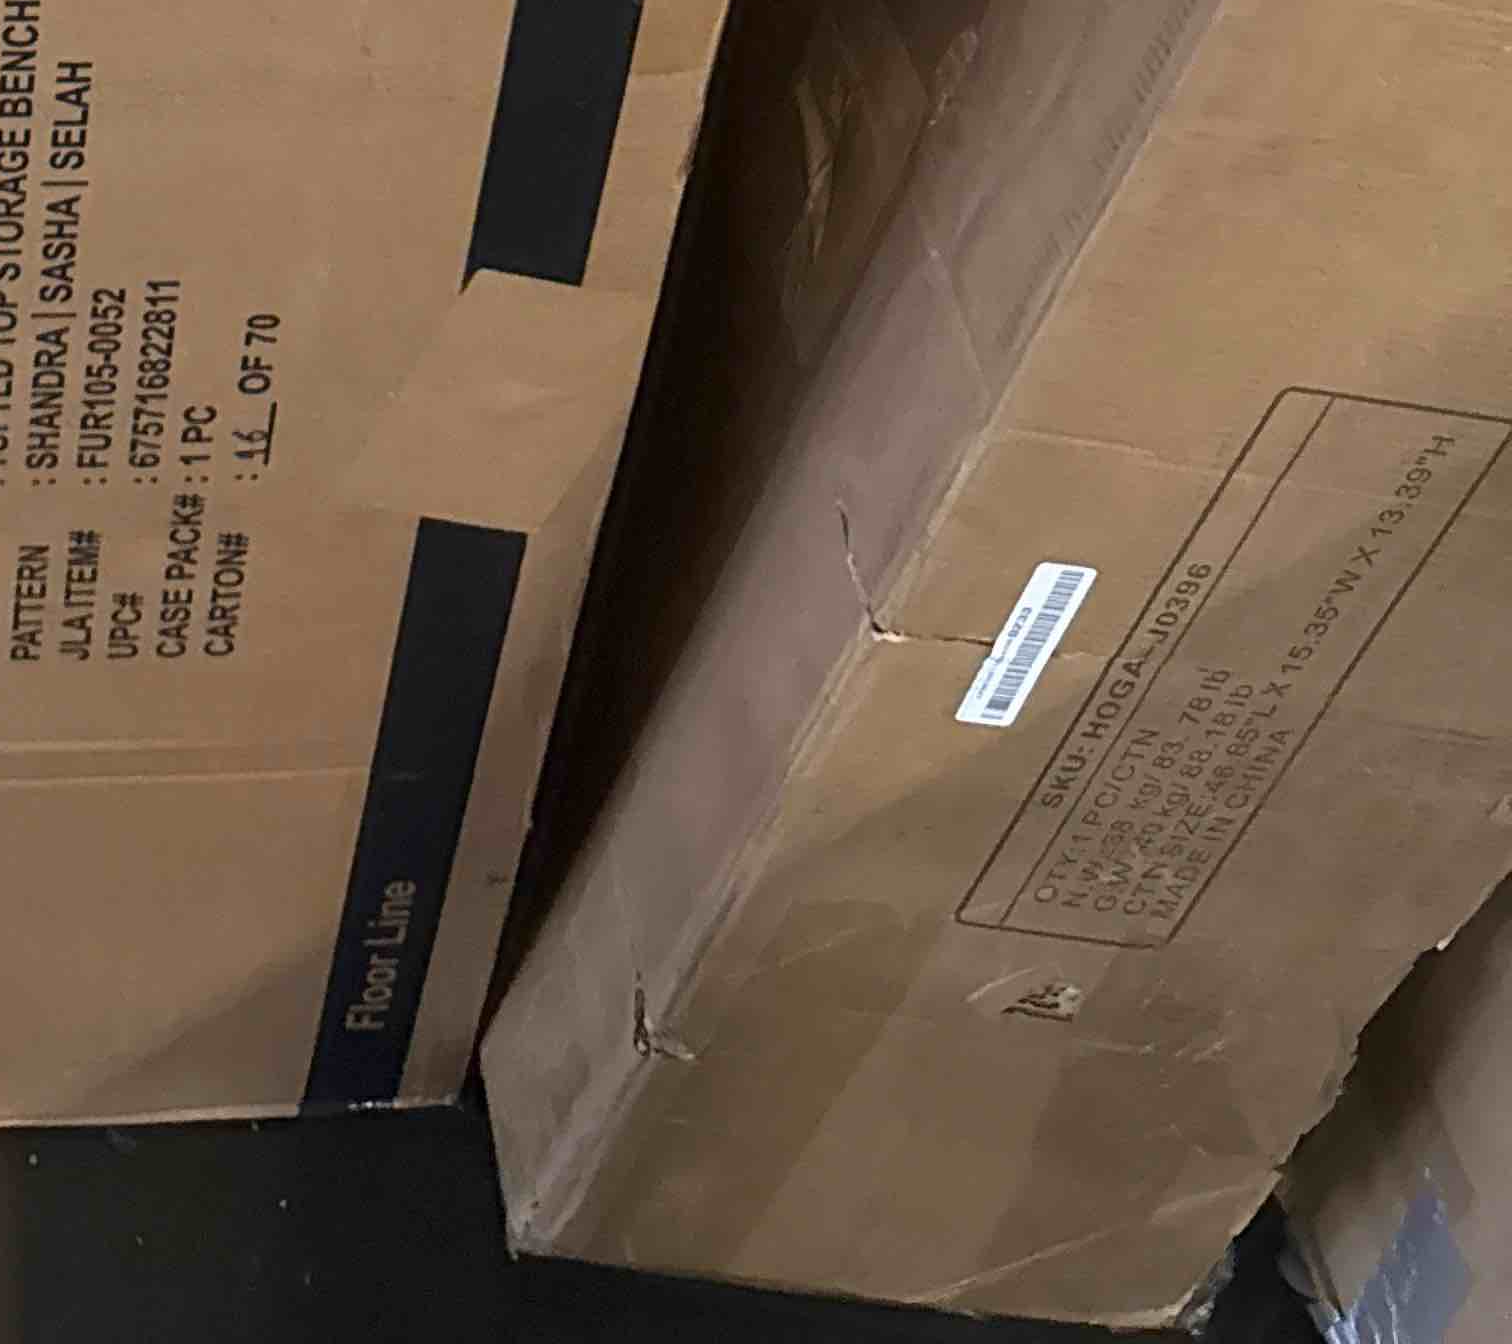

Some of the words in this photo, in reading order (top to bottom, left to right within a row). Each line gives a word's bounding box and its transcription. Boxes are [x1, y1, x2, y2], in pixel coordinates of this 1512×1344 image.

[0, 0, 41, 118] BENCH
[50, 61, 93, 171] SELAH
[40, 197, 82, 303] SASHA
[76, 287, 126, 468] FUR105-0052
[129, 279, 180, 469] 675716822811
[238, 353, 273, 394] OF
[244, 313, 281, 346] 70
[25, 327, 70, 470] SHANDRA
[182, 405, 217, 442] PC
[180, 455, 210, 465] 1
[64, 529, 100, 608] ITEM#
[162, 494, 204, 580] PACK#
[10, 544, 49, 661] PATTERN
[59, 614, 91, 661] JLA
[107, 592, 143, 659] UPC#
[156, 588, 192, 658] CASE
[204, 532, 249, 656] CARTON#
[1039, 746, 1097, 810] SKU:
[1085, 563, 1214, 739] HOGA-J0396
[1122, 862, 1170, 916] CTN
[1265, 681, 1291, 696] X
[1281, 570, 1363, 675] 15.35"W
[1352, 546, 1382, 563] X
[1370, 434, 1457, 540] 13.39"H
[1175, 695, 1214, 725] 78
[1198, 668, 1232, 692] lb
[1076, 727, 1161, 826] PC/CTN
[1175, 711, 1231, 779] 88.18
[1224, 682, 1255, 708] lb
[1152, 847, 1215, 921] MADE
[1202, 816, 1235, 841] IN
[1226, 727, 1295, 810] CHINA
[362, 880, 417, 945] Line
[343, 952, 400, 1031] Floor
